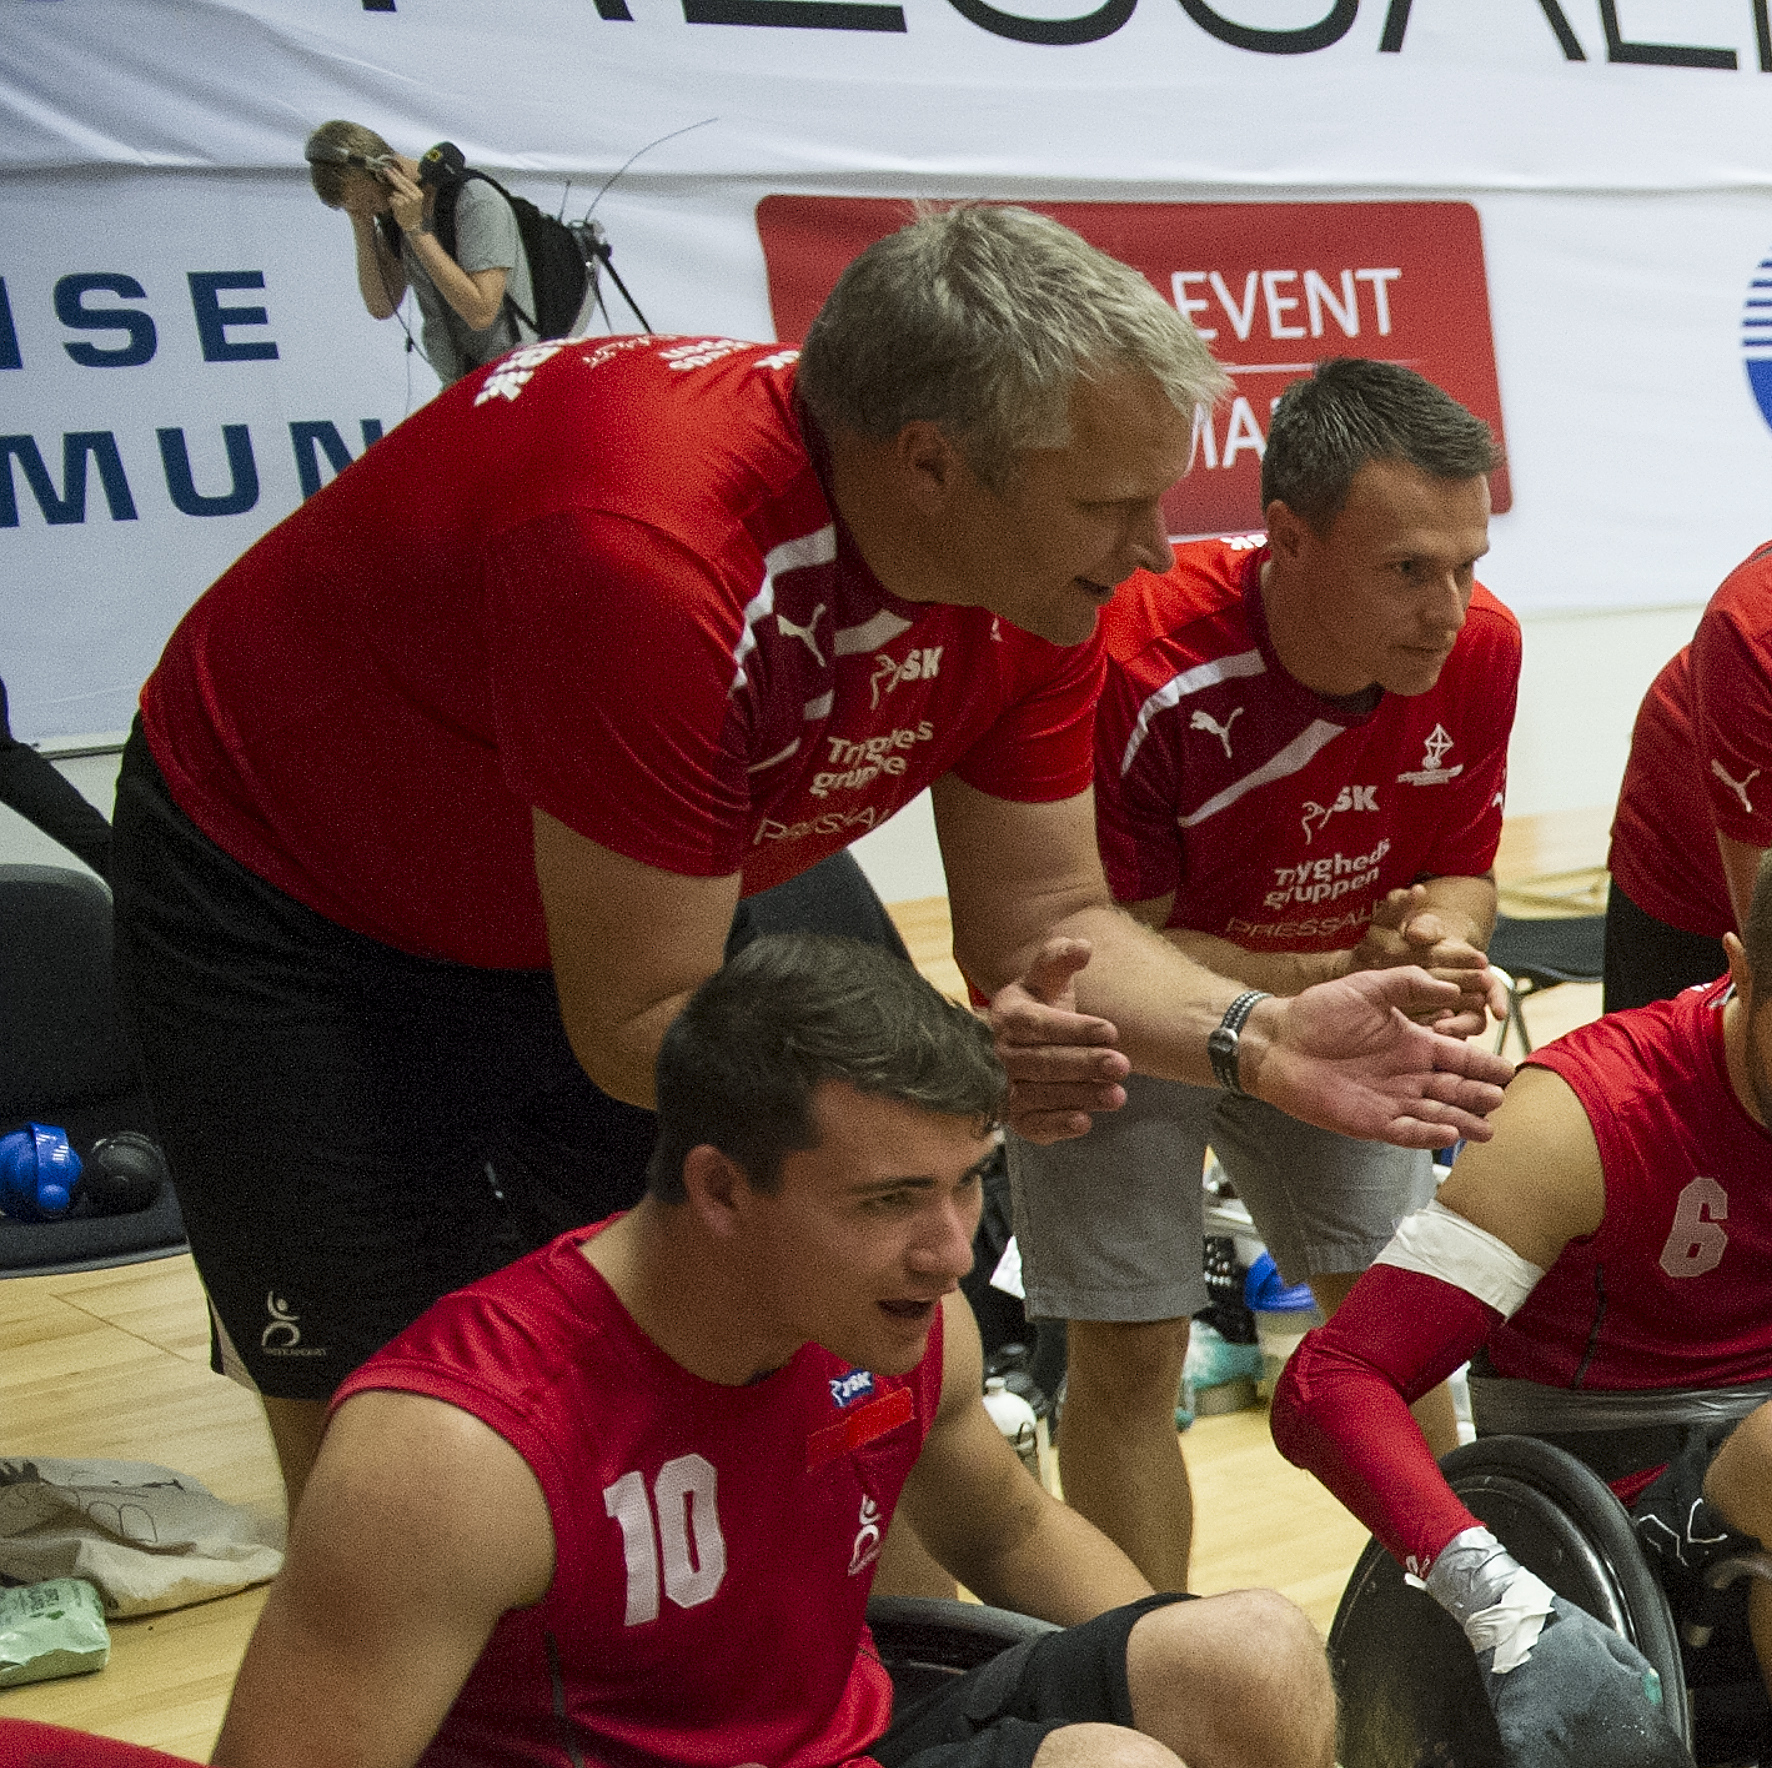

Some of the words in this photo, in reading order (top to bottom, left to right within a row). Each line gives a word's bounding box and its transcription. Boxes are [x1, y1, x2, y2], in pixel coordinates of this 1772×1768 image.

[1171, 267, 1402, 341] EVENT
[1658, 1175, 1730, 1279] 6
[603, 1452, 728, 1628] 10
